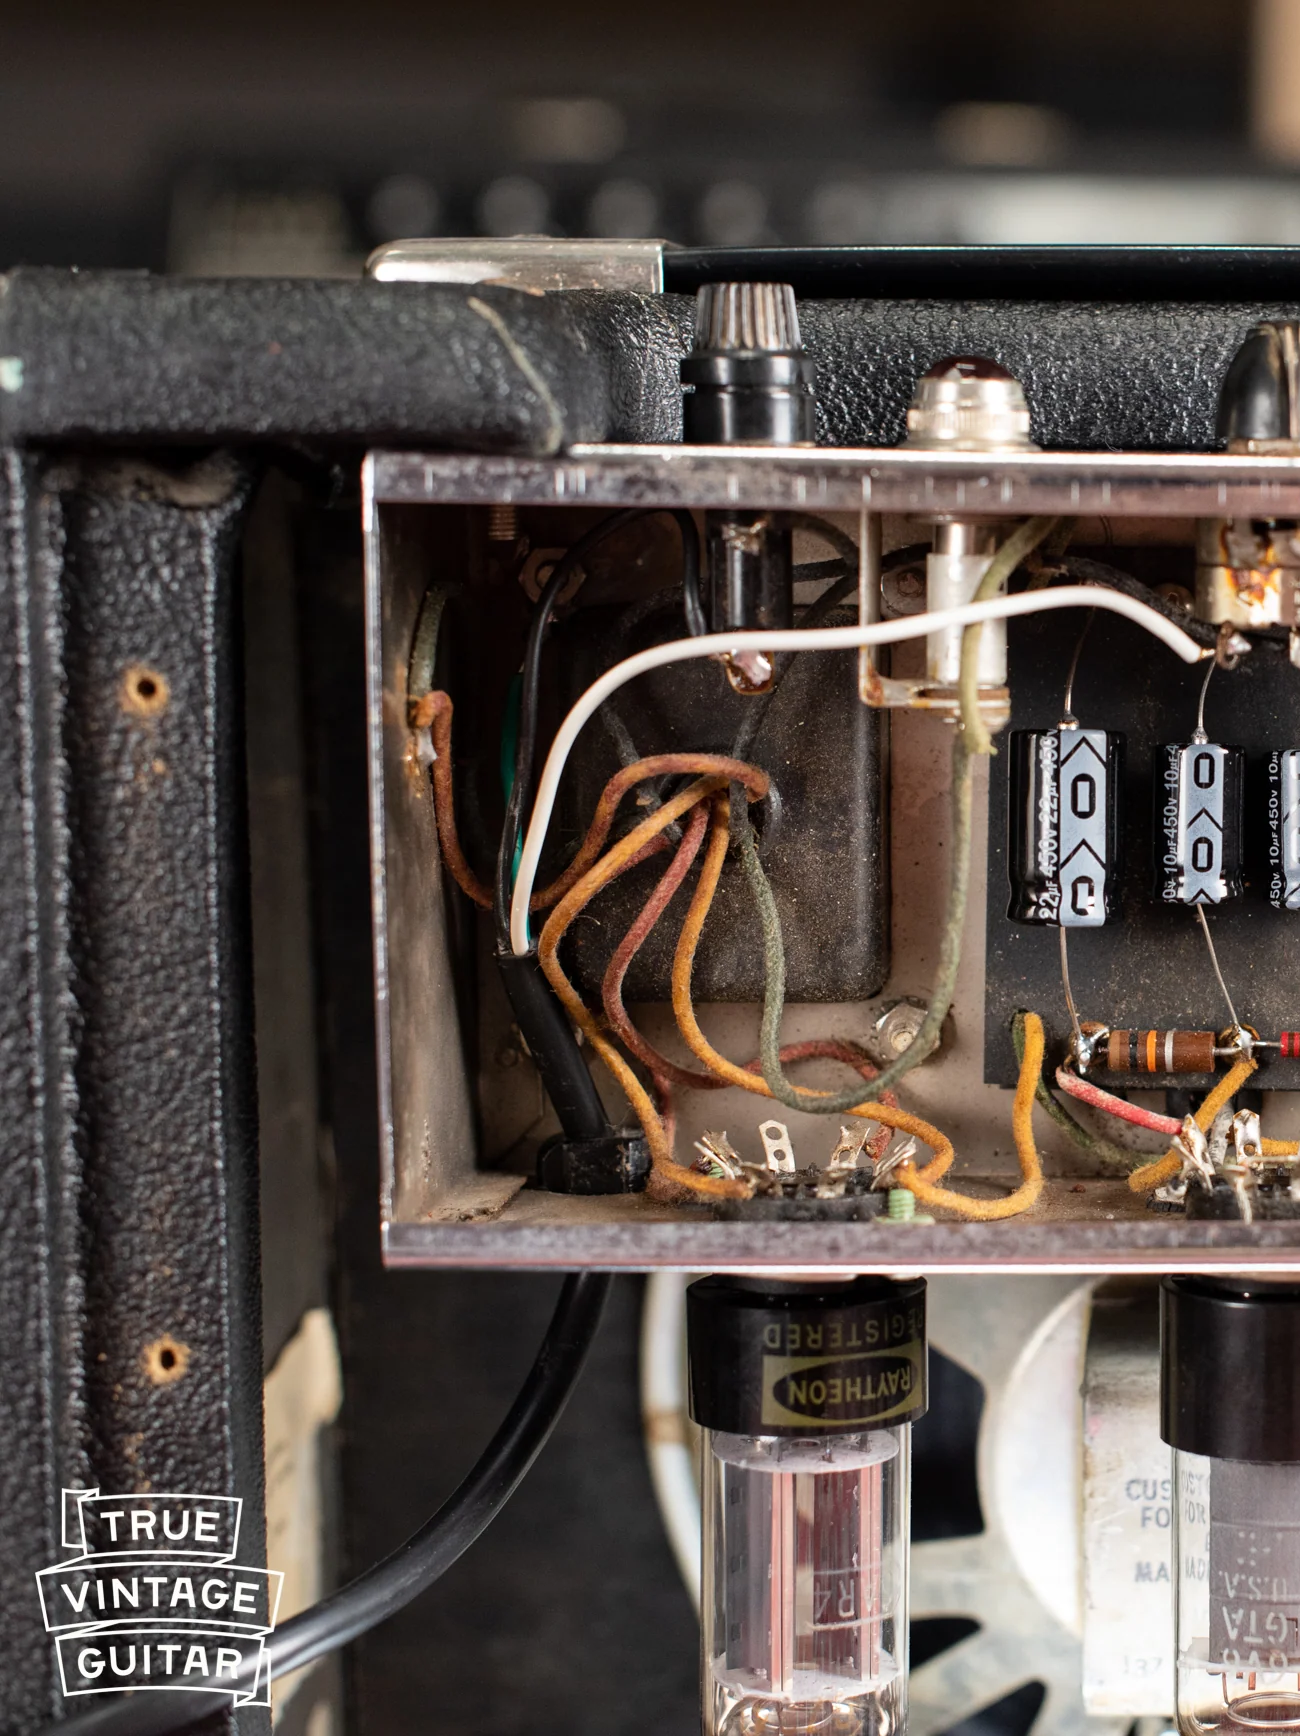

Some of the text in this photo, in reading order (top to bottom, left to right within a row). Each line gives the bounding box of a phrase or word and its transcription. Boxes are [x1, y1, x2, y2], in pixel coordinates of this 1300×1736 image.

[763, 1308, 924, 1349] REGISTERED
[788, 1365, 912, 1404] RAYTHEON
[1125, 1479, 1172, 1501] CUS
[1140, 1506, 1172, 1528] FO
[1222, 1605, 1288, 1643] GTA
